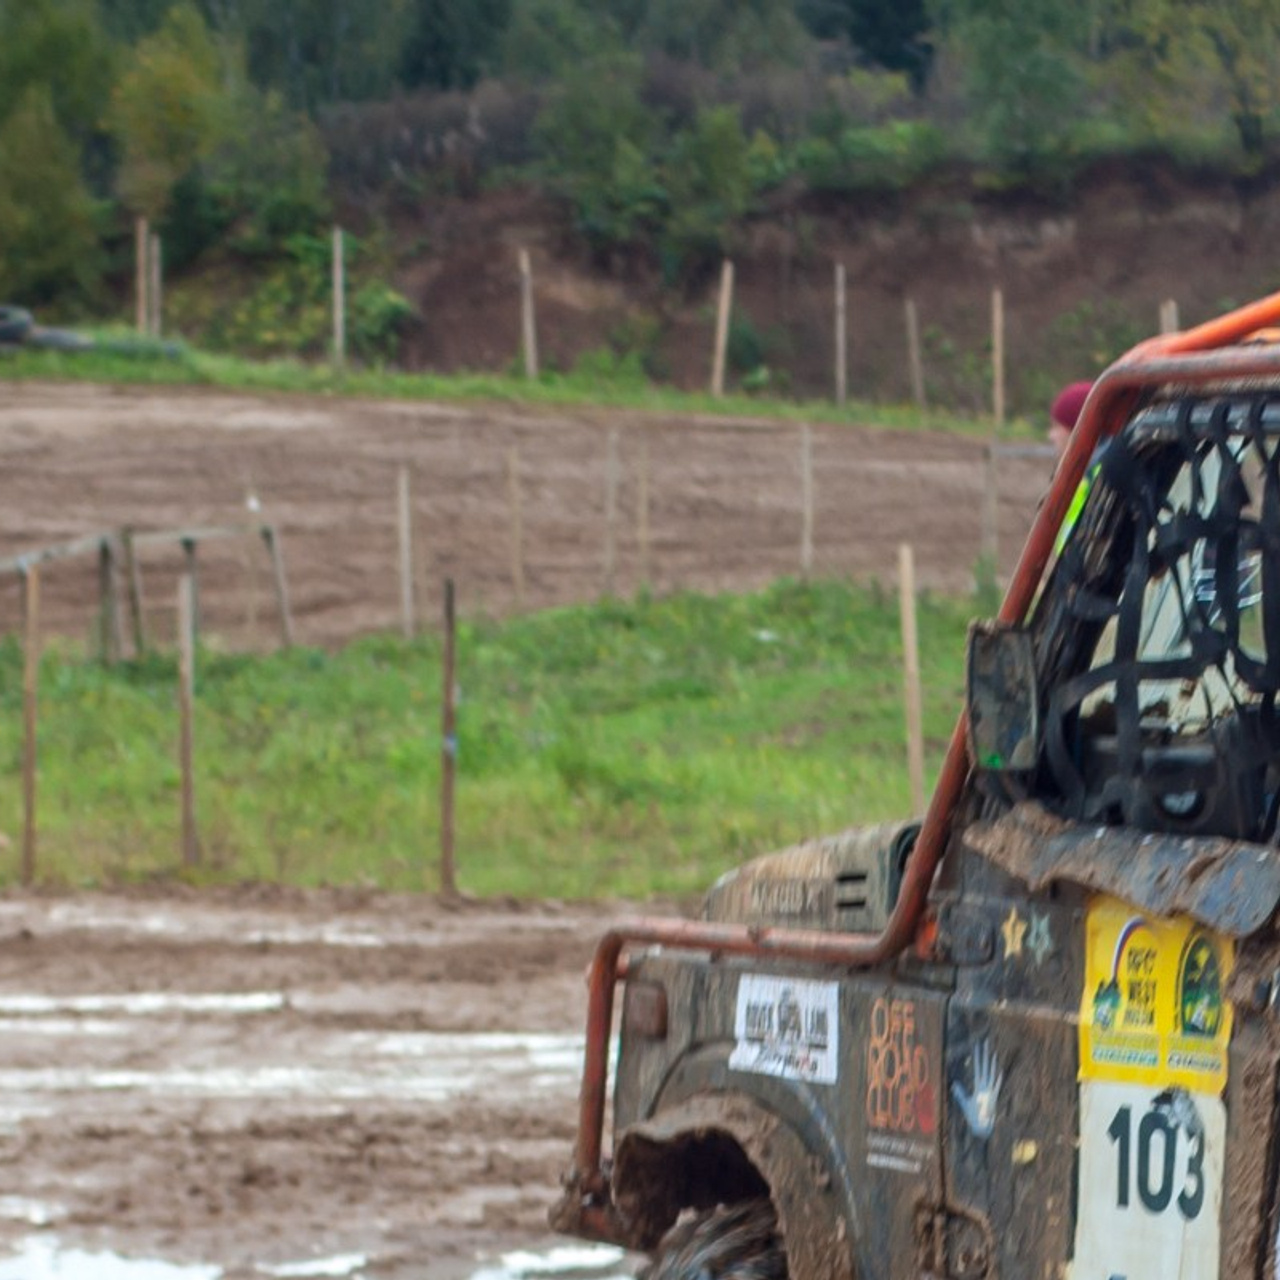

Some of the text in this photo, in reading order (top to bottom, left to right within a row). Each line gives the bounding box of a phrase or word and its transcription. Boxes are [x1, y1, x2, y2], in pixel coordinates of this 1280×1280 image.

[871, 997, 915, 1047] OFF
[868, 1043, 929, 1091] ROAD
[1107, 1103, 1205, 1221] 103
